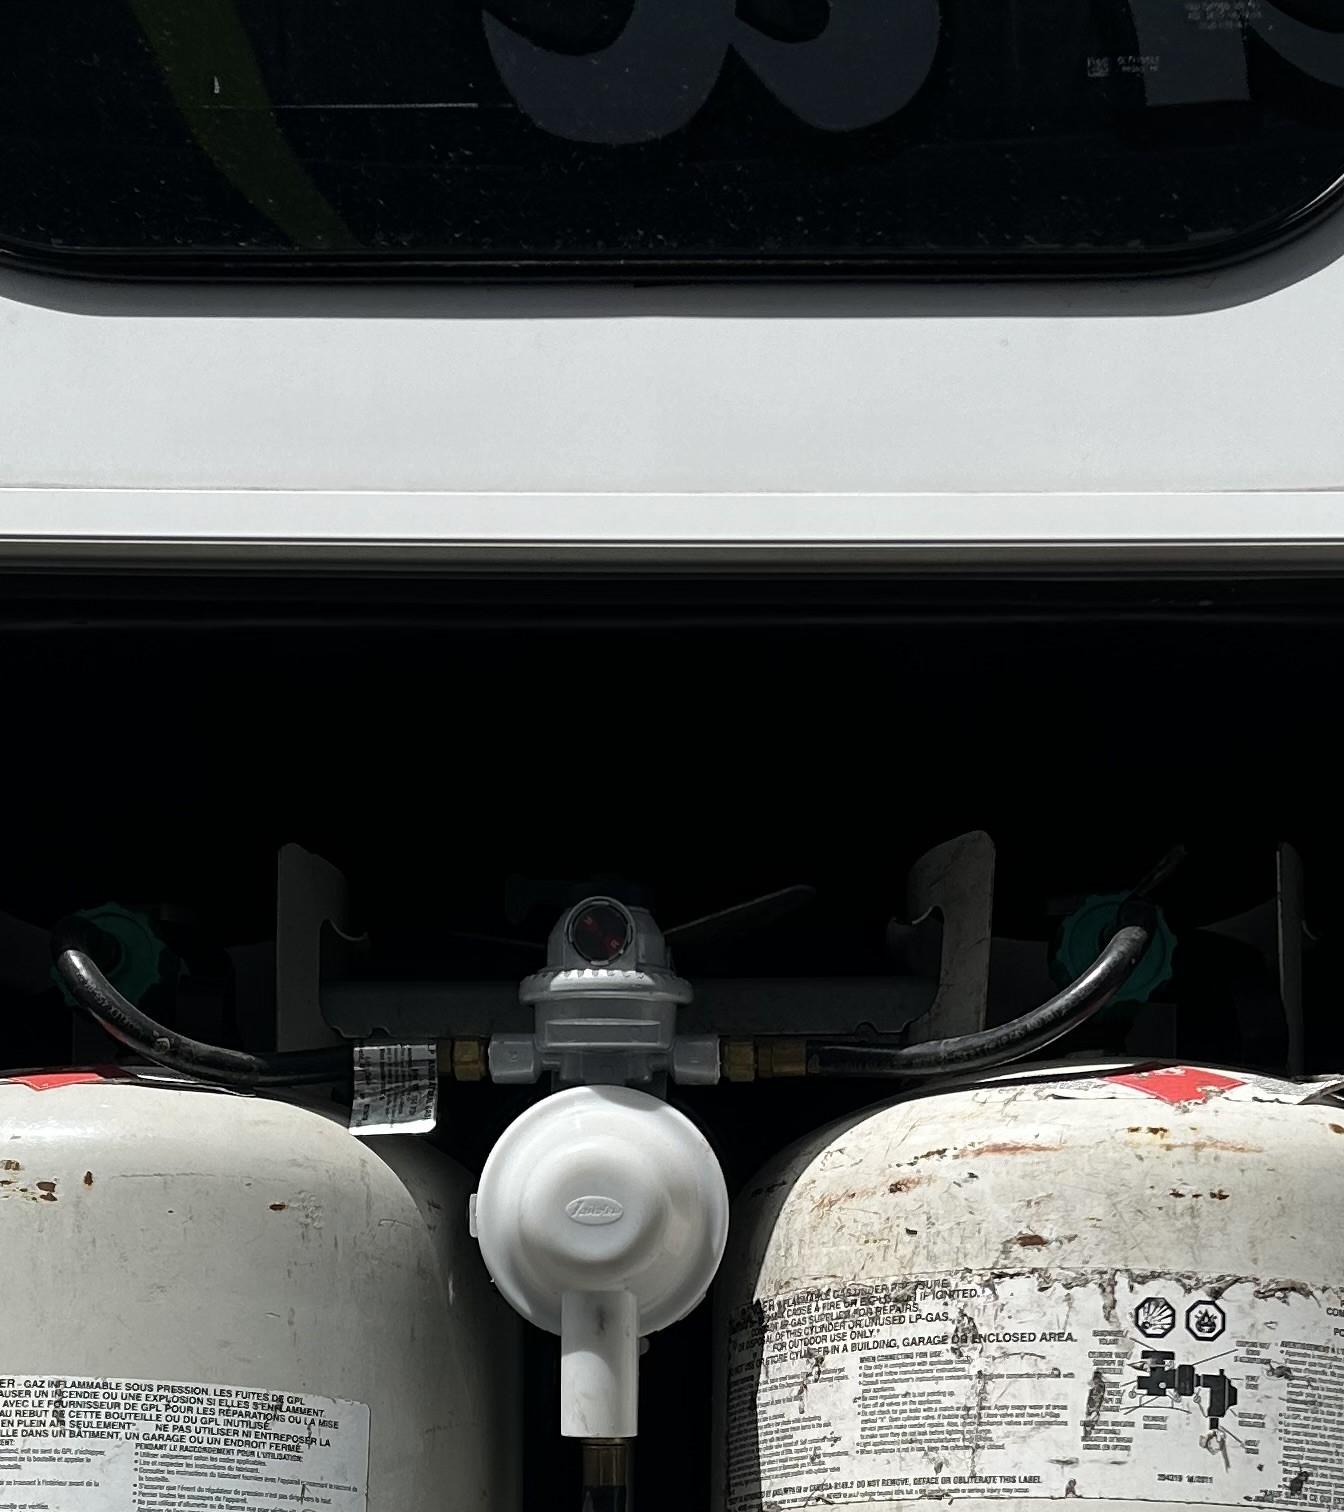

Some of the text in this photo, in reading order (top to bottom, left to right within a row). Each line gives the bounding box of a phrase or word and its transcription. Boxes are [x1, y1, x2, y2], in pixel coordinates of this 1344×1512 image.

[830, 1332, 848, 1342] USE
[902, 1335, 948, 1347] GARAGE
[1039, 1332, 1078, 1342] AREA.
[23, 1380, 45, 1388] GAZ
[47, 1380, 122, 1391] INFLAMMABLE
[125, 1382, 154, 1392] SOUS
[213, 1389, 232, 1398] LES
[236, 1391, 269, 1402] FUITES
[34, 1390, 49, 1398] UN
[51, 1390, 100, 1400] INCENDIE
[103, 1391, 118, 1400] OU
[121, 1392, 143, 1402] UNE
[145, 1393, 204, 1406] EXPLOSION
[206, 1397, 216, 1407] SI
[219, 1399, 249, 1410] ELLES
[2, 1400, 29, 1409] AVEC
[32, 1400, 44, 1408] LE
[47, 1400, 121, 1411] FOURNISSEUR
[124, 1402, 137, 1411] DE
[141, 1403, 162, 1413] GPL
[164, 1403, 193, 1414] POUR
[196, 1406, 215, 1416] LES
[288, 1415, 301, 1425] OU
[304, 1417, 316, 1427] LA
[15, 1410, 49, 1418] REBUT
[68, 1410, 101, 1420] CETTE
[105, 1411, 162, 1422] BOUTEILLE
[165, 1414, 180, 1423] OU
[183, 1415, 197, 1425] DU
[200, 1417, 220, 1427] GPL
[1, 1420, 14, 1428] EN
[17, 1419, 46, 1428] PLEIN
[155, 1423, 169, 1432] NE
[172, 1424, 192, 1434] PAS
[195, 1426, 240, 1438] UTILISER
[242, 1430, 252, 1439] NI
[254, 1431, 317, 1446] ENTREPOSER
[319, 1438, 331, 1448] LA
[21, 1429, 49, 1438] DANS
[51, 1429, 66, 1438] UN
[125, 1432, 139, 1441] UN
[142, 1432, 186, 1443] GARAGE
[189, 1435, 204, 1444] OU
[206, 1436, 221, 1446] UN
[223, 1437, 266, 1450] ENDROIT
